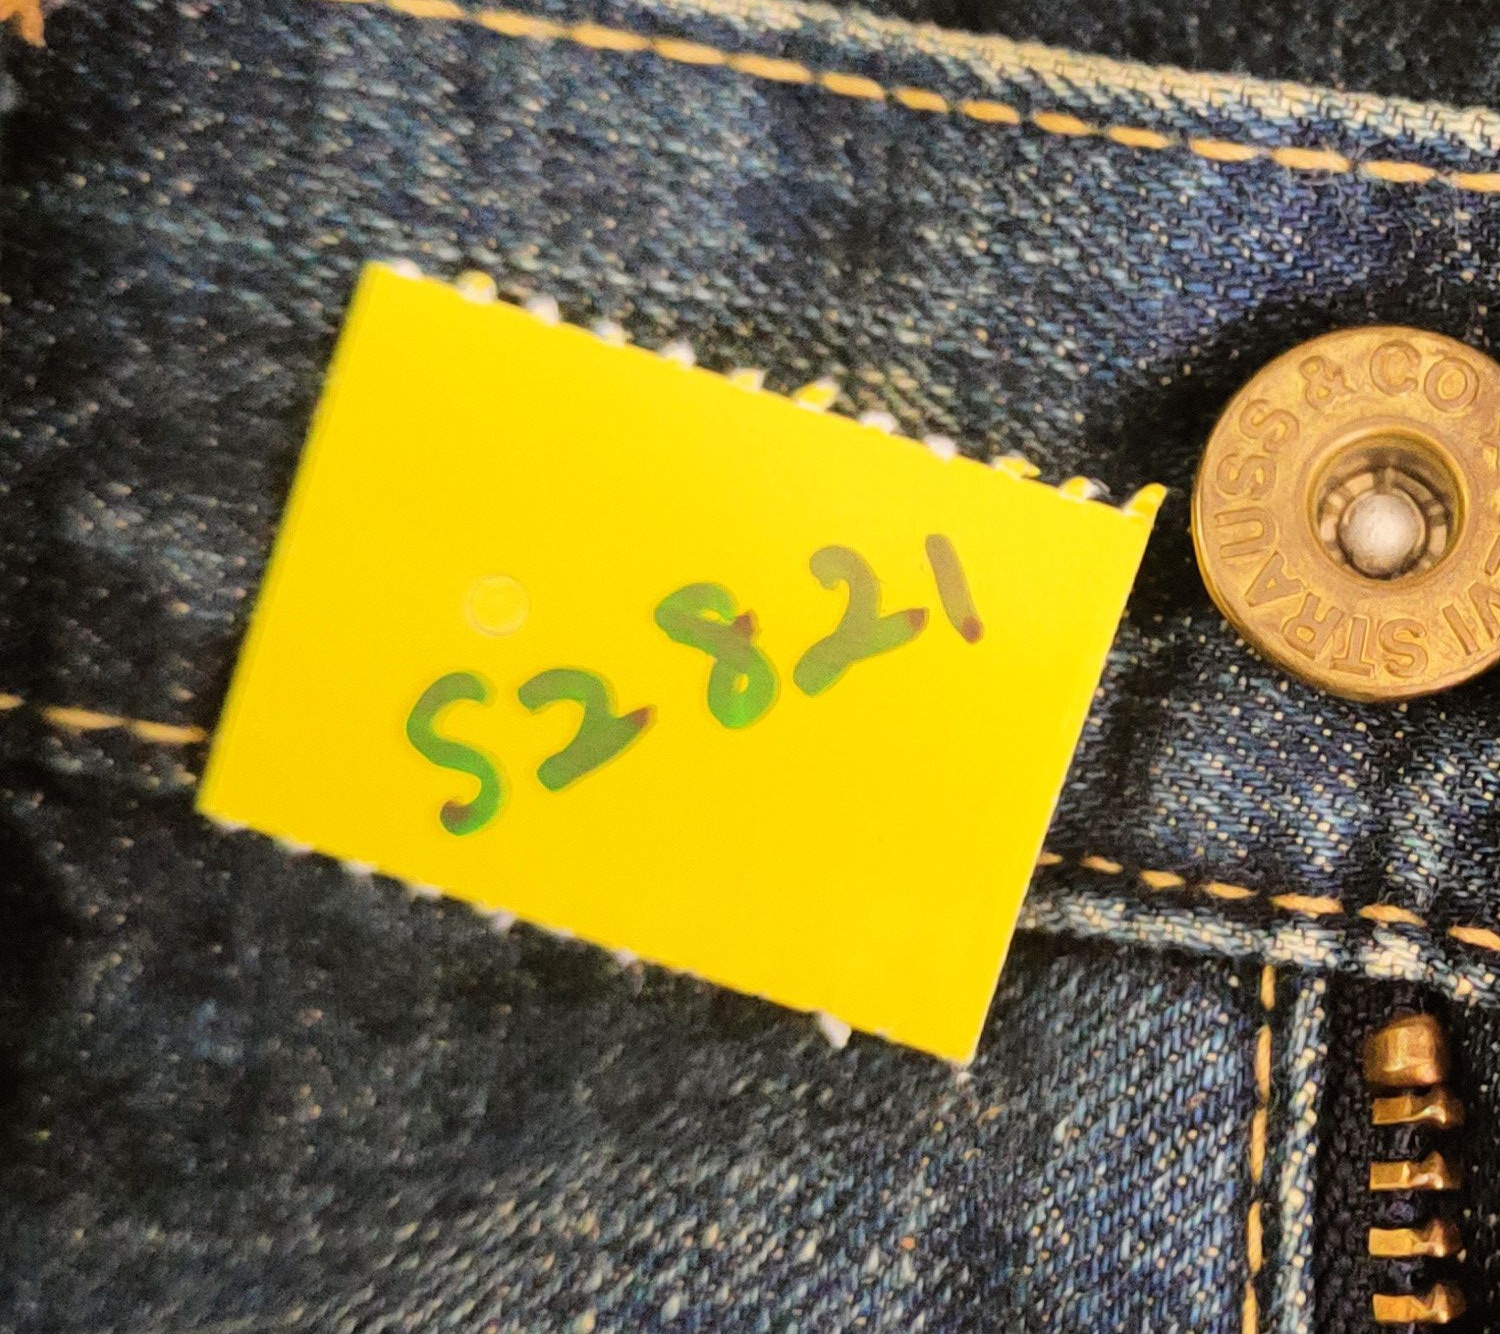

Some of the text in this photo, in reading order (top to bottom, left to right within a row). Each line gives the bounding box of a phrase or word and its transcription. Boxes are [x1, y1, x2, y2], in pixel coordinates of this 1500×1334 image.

[1297, 354, 1357, 411] &
[1368, 338, 1480, 414] CO
[1214, 397, 1430, 679] STRAUSS
[405, 532, 985, 837] S2821
